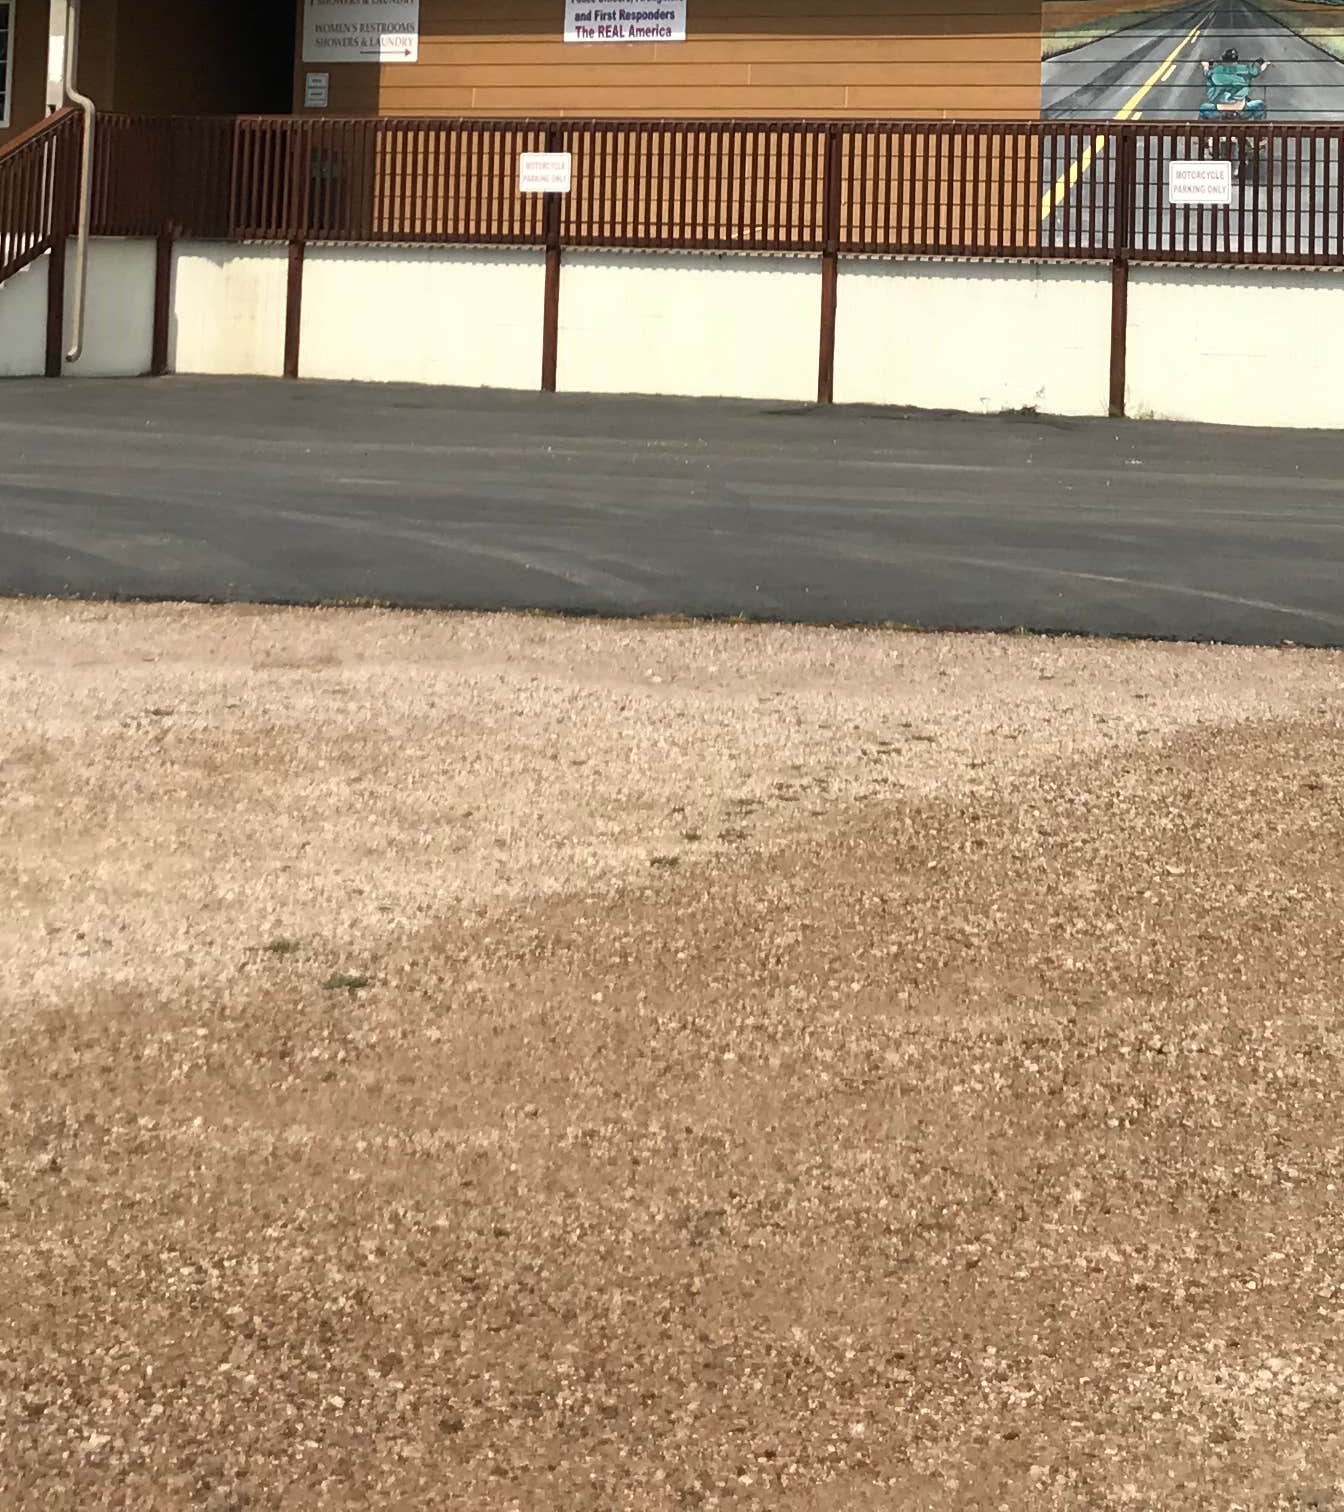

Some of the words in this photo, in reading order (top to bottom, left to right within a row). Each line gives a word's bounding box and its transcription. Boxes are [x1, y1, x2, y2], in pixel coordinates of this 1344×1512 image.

[574, 10, 592, 22] and
[594, 9, 616, 21] First
[619, 9, 675, 23] Responders
[360, 22, 415, 33] RESTROOMS
[575, 25, 595, 38] The
[598, 24, 625, 38] REAL
[628, 24, 672, 38] America
[369, 36, 414, 48] LAUNDRY
[1176, 170, 1224, 180] MOTORCYCLE
[1173, 184, 1206, 194] PARKING
[1208, 184, 1227, 194] ONLY
